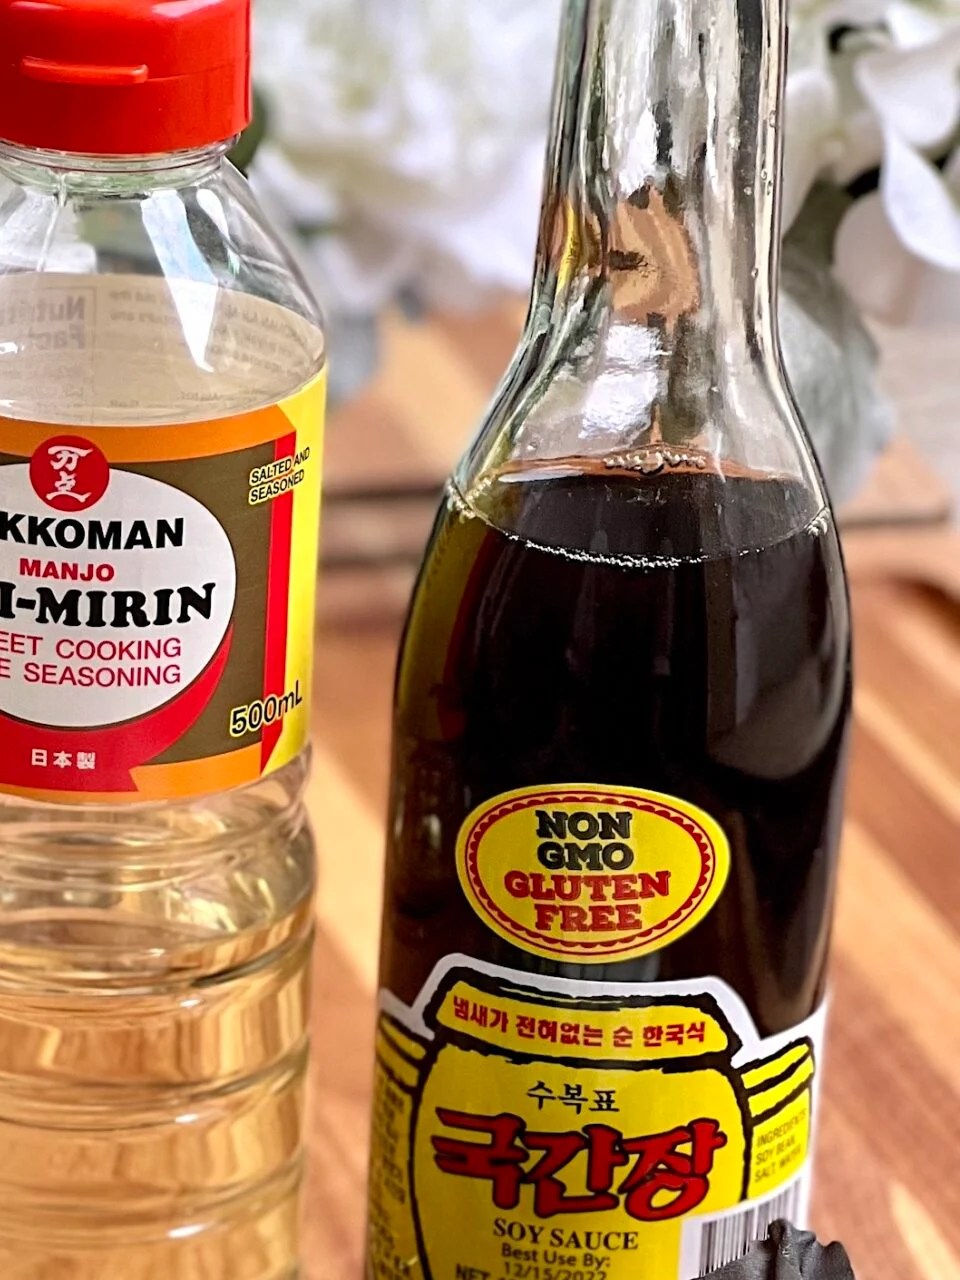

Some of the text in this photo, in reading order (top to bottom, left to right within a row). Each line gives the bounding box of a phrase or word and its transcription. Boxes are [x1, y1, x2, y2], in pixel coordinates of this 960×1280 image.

[250, 446, 310, 484] SALTED AND
[250, 468, 304, 503] SEASONED
[19, 558, 115, 581] MANJO
[56, 637, 181, 661] COOKING
[23, 662, 181, 686] SEASONING
[230, 680, 302, 735] 500mL
[31, 748, 96, 770] 日本製
[535, 810, 632, 840] NON
[537, 842, 634, 870] GMO
[504, 870, 671, 900] GLUTEN
[535, 903, 642, 931] FREE
[453, 995, 508, 1032] 냄새가
[613, 1026, 633, 1047] 순
[643, 1021, 706, 1047] 한국식
[526, 1081, 620, 1114] 수복표
[431, 1106, 728, 1220] 국간장
[493, 1218, 639, 1250] SOY SAUCE
[501, 1242, 611, 1269] Best Use By:
